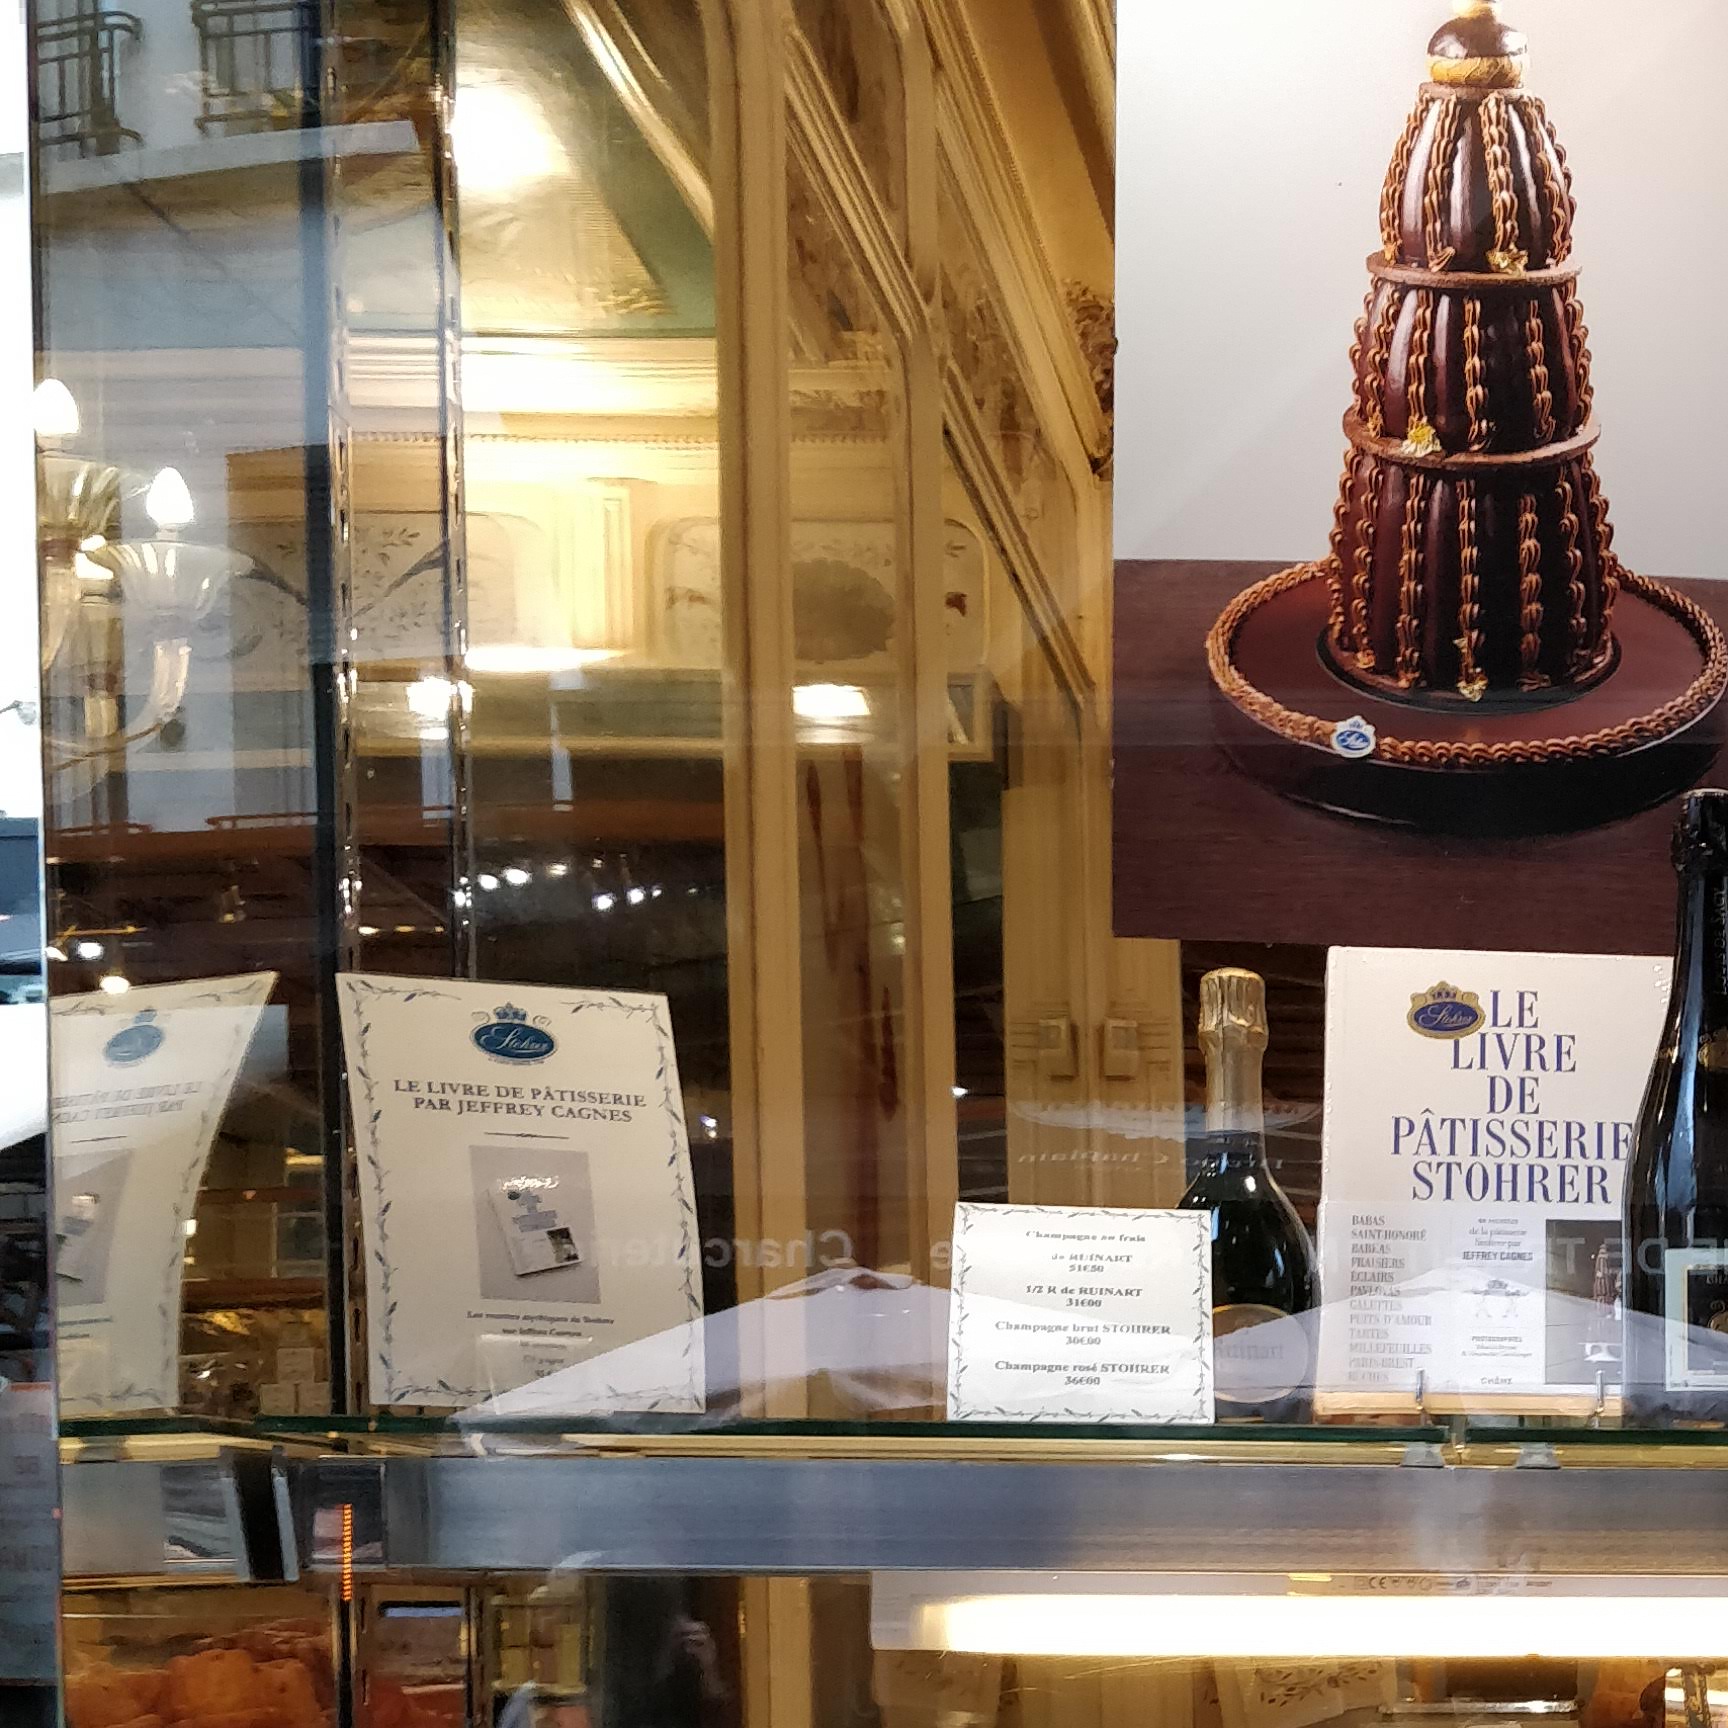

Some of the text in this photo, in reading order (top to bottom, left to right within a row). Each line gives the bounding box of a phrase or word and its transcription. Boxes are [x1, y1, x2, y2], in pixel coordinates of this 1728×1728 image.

[1489, 989, 1539, 1028] LE
[1450, 1032, 1577, 1073] LIVRE
[394, 1079, 648, 1107] LE LIVRE DE PÂTISSERIE
[1487, 1075, 1540, 1115] DE
[413, 1097, 633, 1122] PAR JEFFREY CAGNES
[1391, 1108, 1633, 1160] PÂTISSERIE
[1412, 1160, 1612, 1204] STOHRER
[1352, 1215, 1385, 1226] BABAS
[1060, 1287, 1076, 1295] de
[1078, 1287, 1143, 1297] RUINART
[994, 1320, 1171, 1335] Champagne brut STOHRER
[994, 1360, 1170, 1374] Champagne rosé STOHRER
